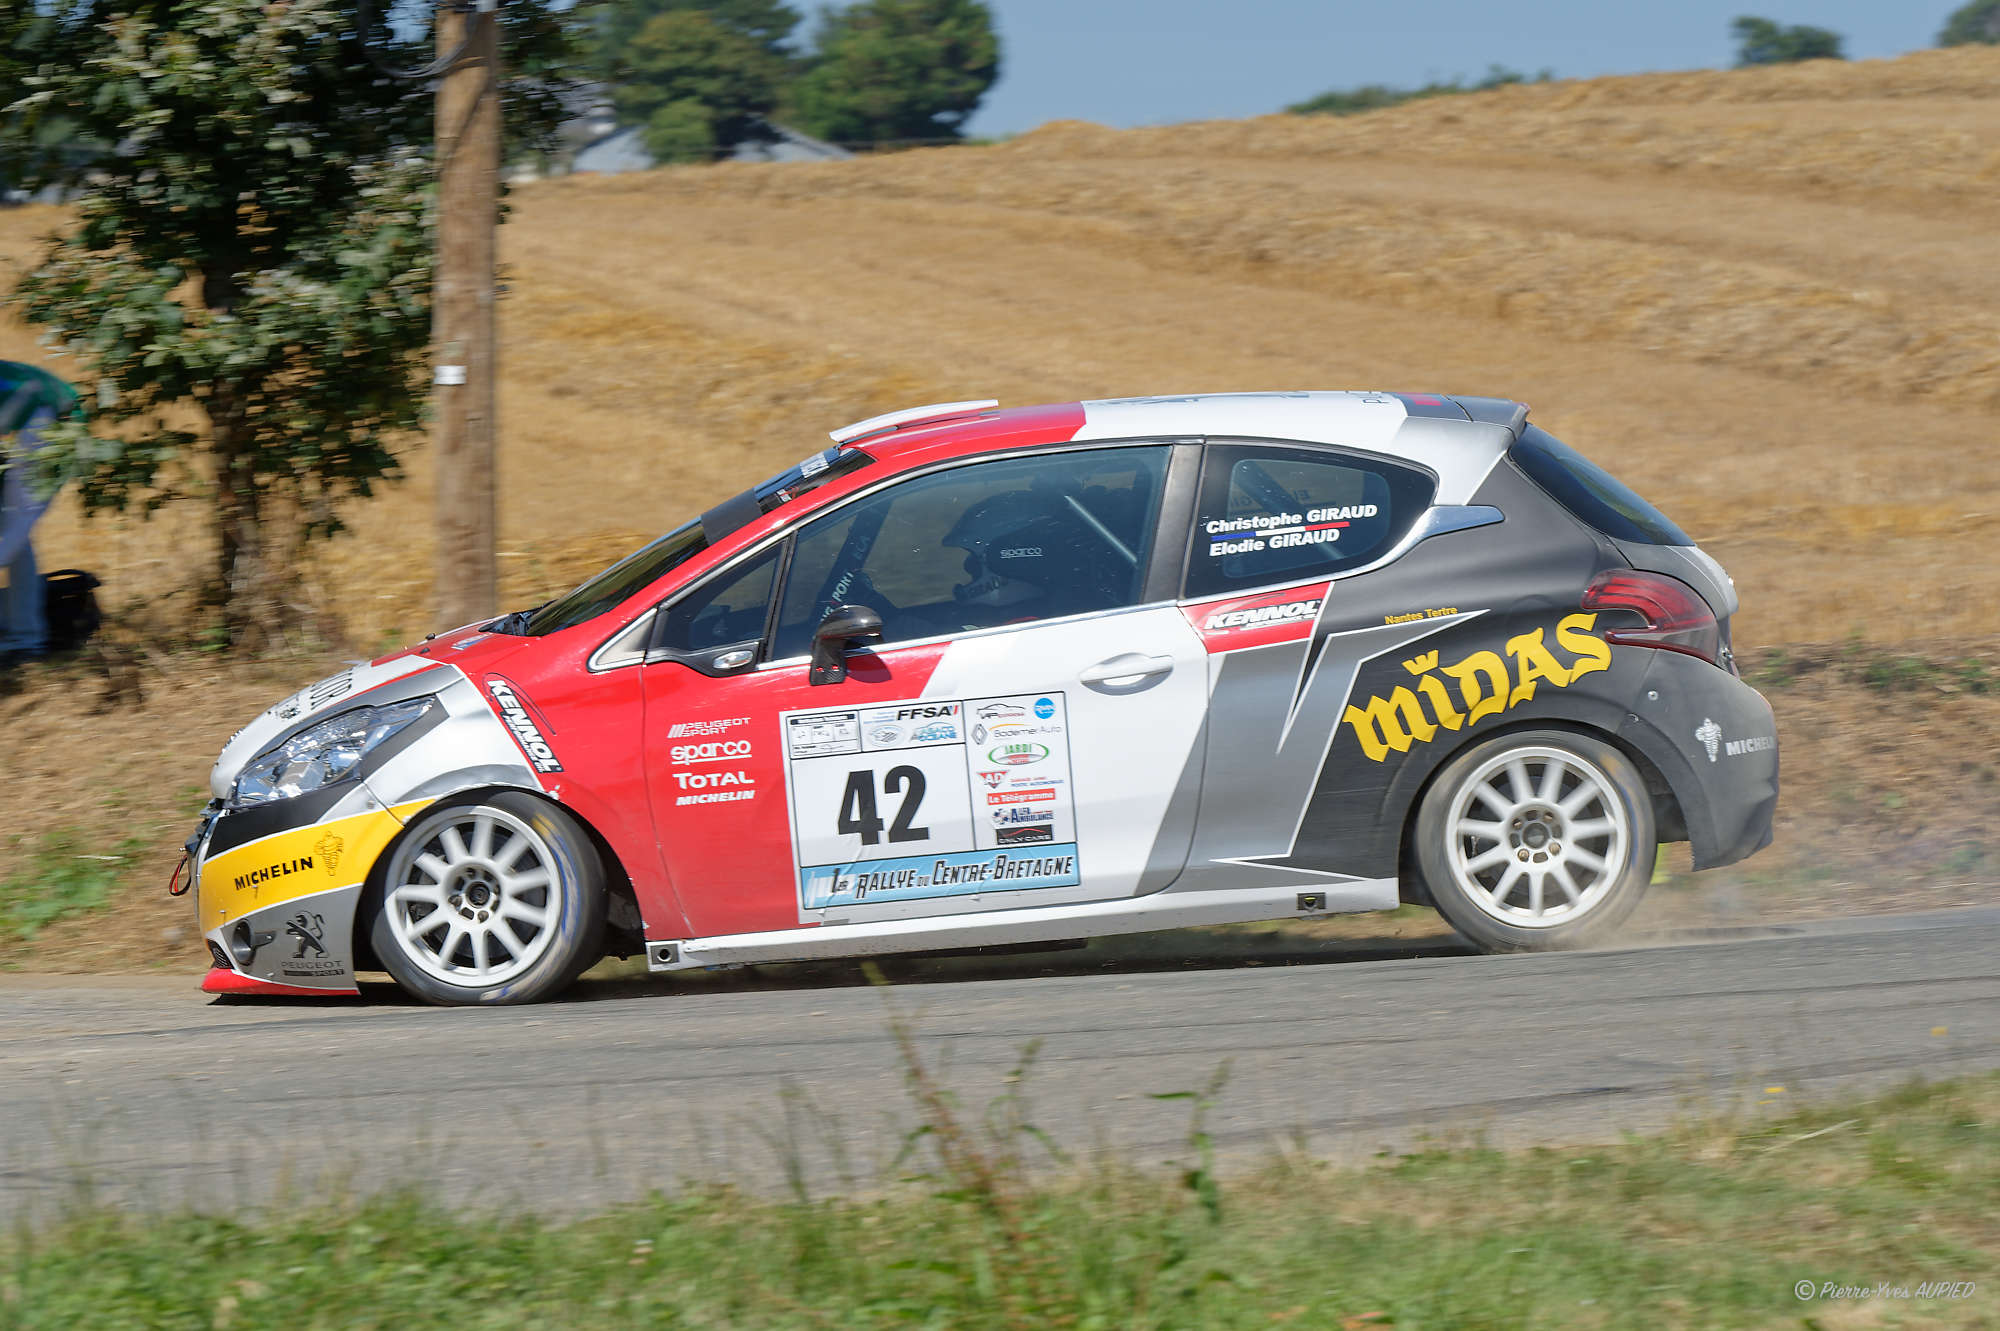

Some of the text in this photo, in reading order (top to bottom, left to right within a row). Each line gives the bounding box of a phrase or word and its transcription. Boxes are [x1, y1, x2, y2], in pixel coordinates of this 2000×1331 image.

[1206, 504, 1378, 534] Christophe GIRAUD
[1000, 547, 1044, 560] sparco
[1209, 529, 1340, 557] Elodie GIRAUD
[1203, 600, 1318, 630] KENNOL
[1384, 607, 1458, 625] Nantes Tertre
[1342, 613, 1612, 763] MIDAS
[487, 680, 561, 772] KENNOL
[684, 717, 752, 729] PEUGEOT
[897, 705, 952, 721] FFSA
[681, 726, 729, 737] SPORT
[670, 739, 752, 766] sparco
[675, 789, 756, 807] MICHELIN
[837, 765, 930, 846] 42
[234, 856, 314, 892] MICHELIN
[280, 960, 344, 970] PEUGEOT
